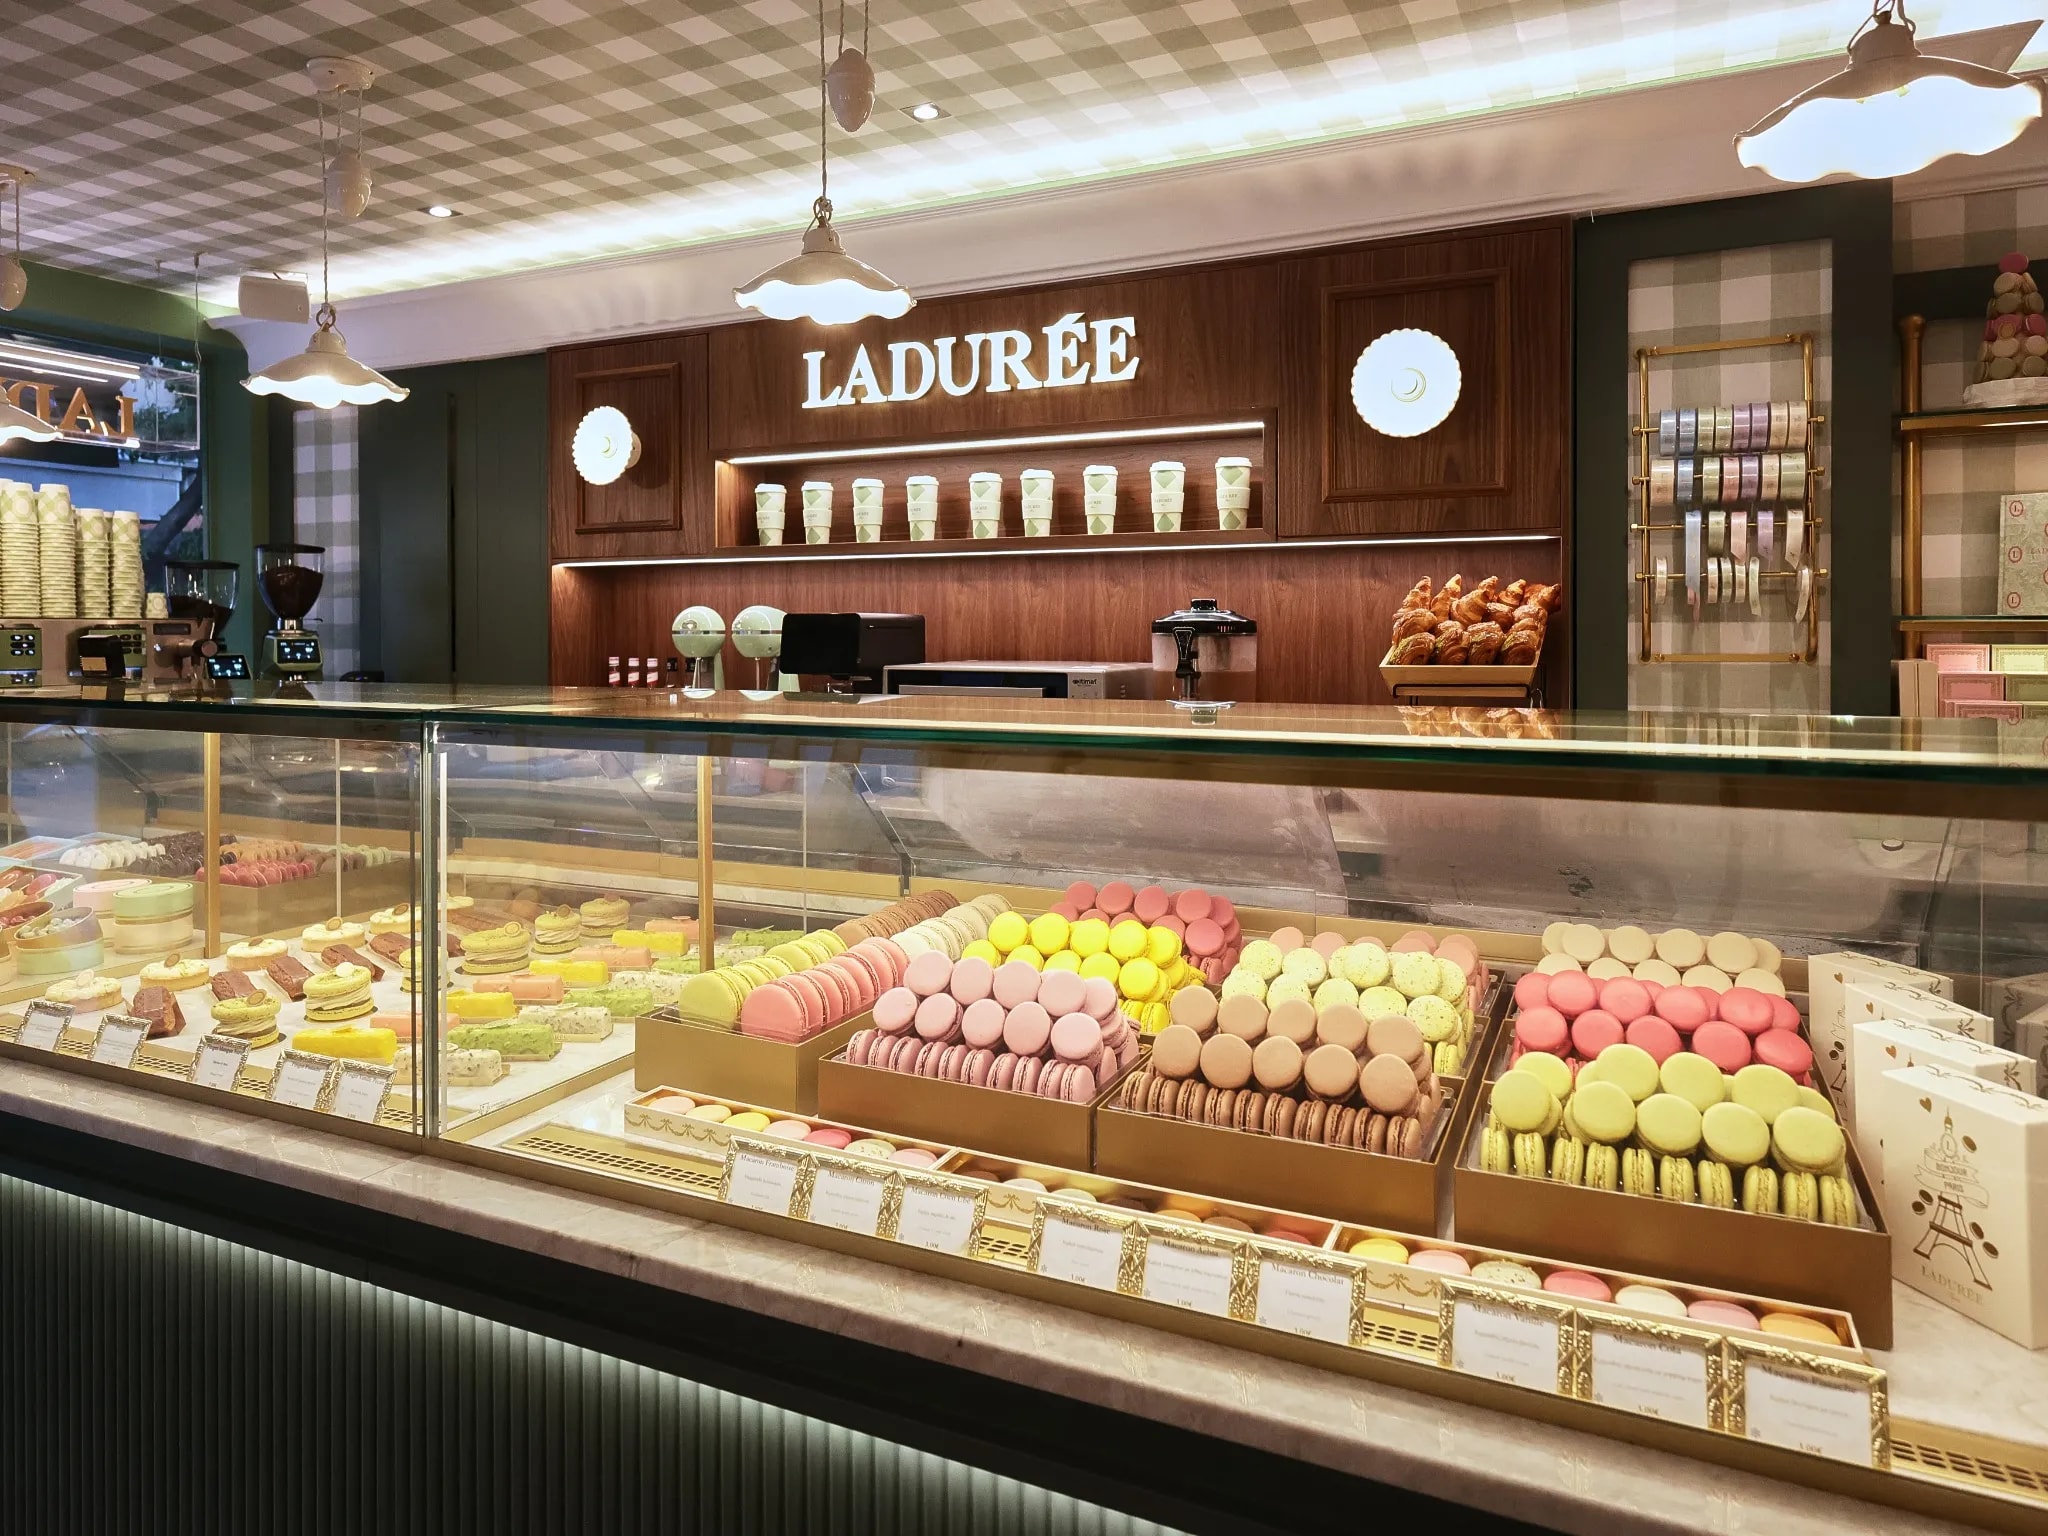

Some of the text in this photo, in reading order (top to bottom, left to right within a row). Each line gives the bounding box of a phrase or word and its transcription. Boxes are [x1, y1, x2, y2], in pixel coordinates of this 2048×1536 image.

[801, 312, 1140, 409] LADURÉE
[741, 1154, 764, 1166] Macaron
[1272, 1262, 1344, 1285] Macaron Chocolat
